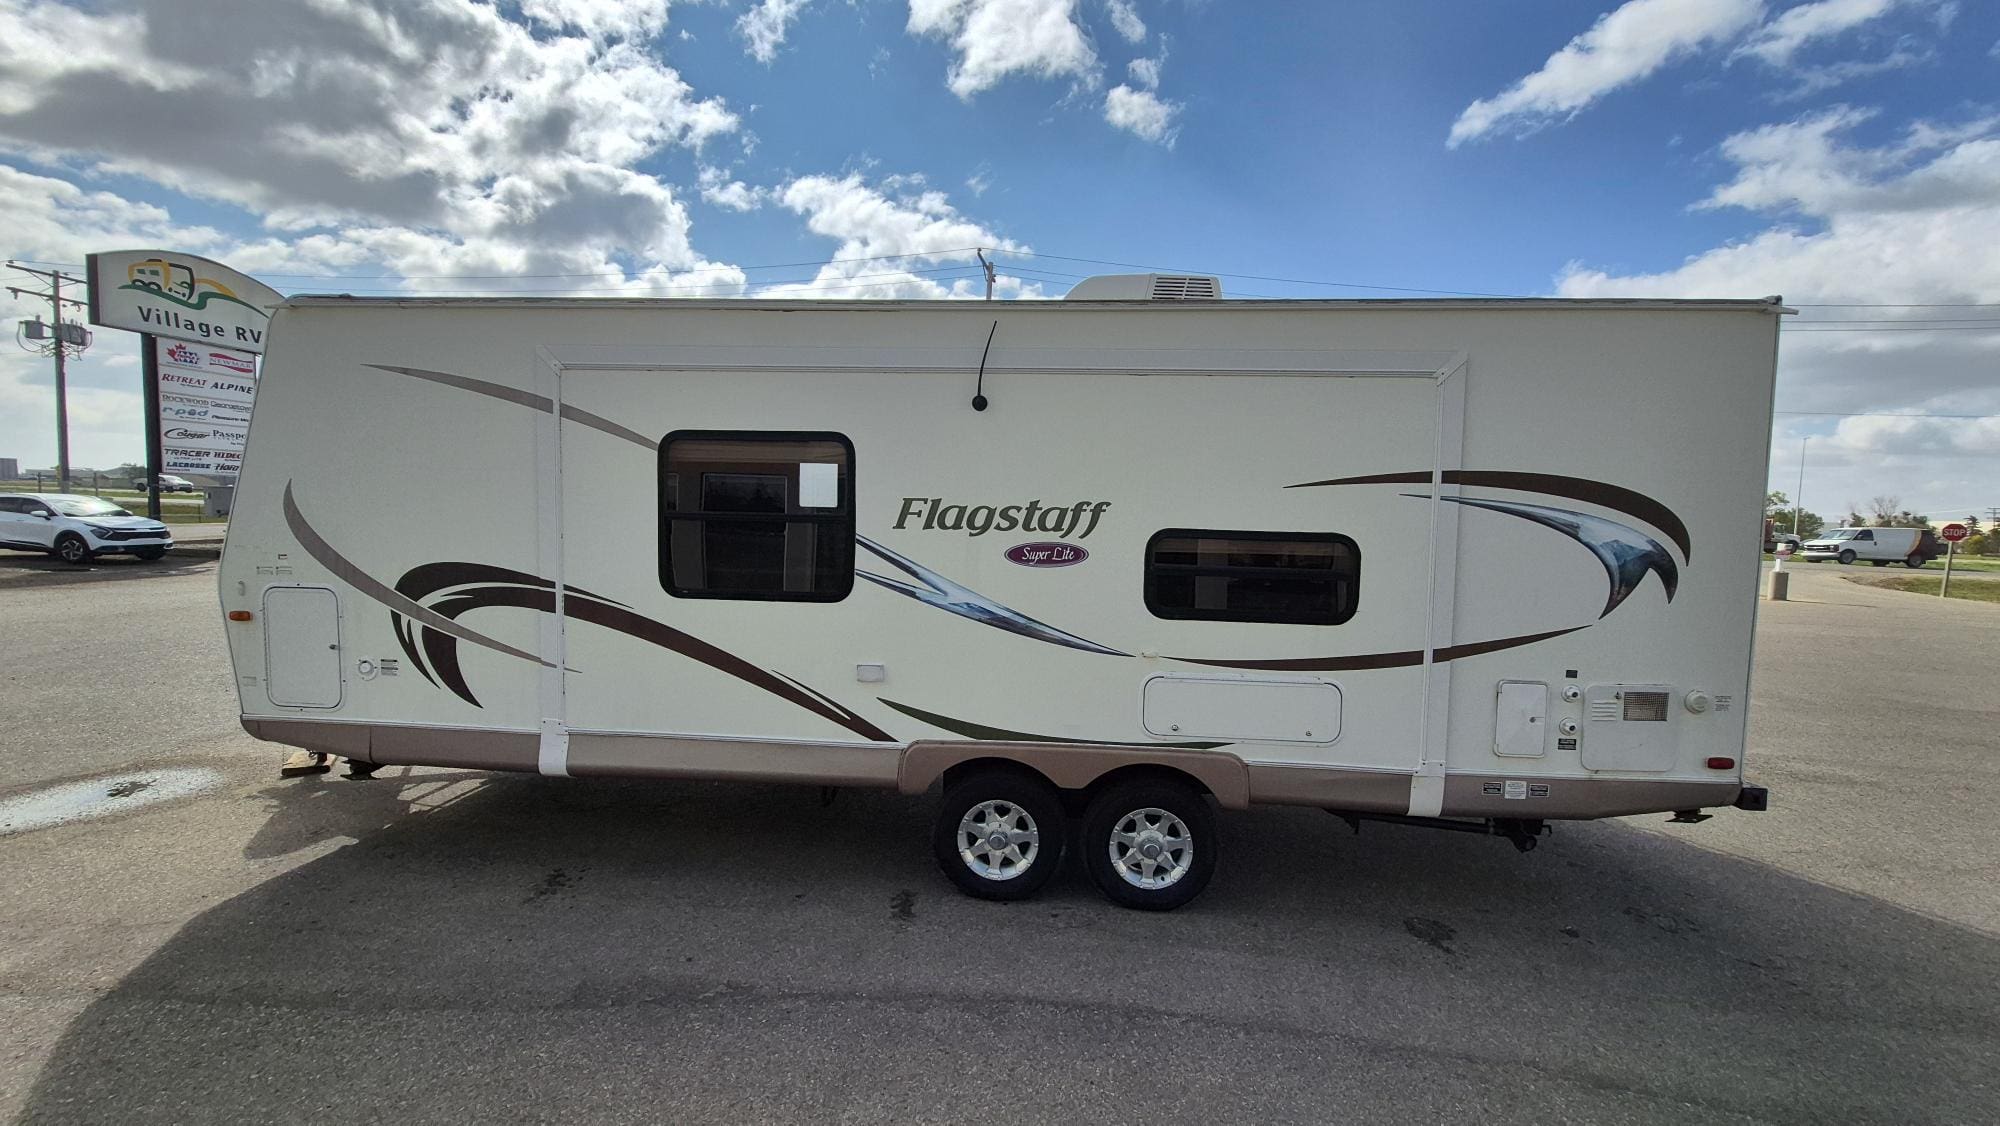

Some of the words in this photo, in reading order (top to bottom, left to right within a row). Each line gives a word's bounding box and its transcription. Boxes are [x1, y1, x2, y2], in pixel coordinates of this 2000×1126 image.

[137, 305, 225, 338] Village
[235, 326, 262, 344] RV
[161, 373, 208, 386] RETREAT
[210, 382, 254, 395] ALPINE
[163, 427, 210, 440] Cougar
[164, 448, 211, 458] TRACER
[892, 498, 1112, 539] Flagstaff
[1943, 528, 1966, 537] STOP
[1021, 546, 1051, 565] Super
[1052, 547, 1075, 561] Lite
